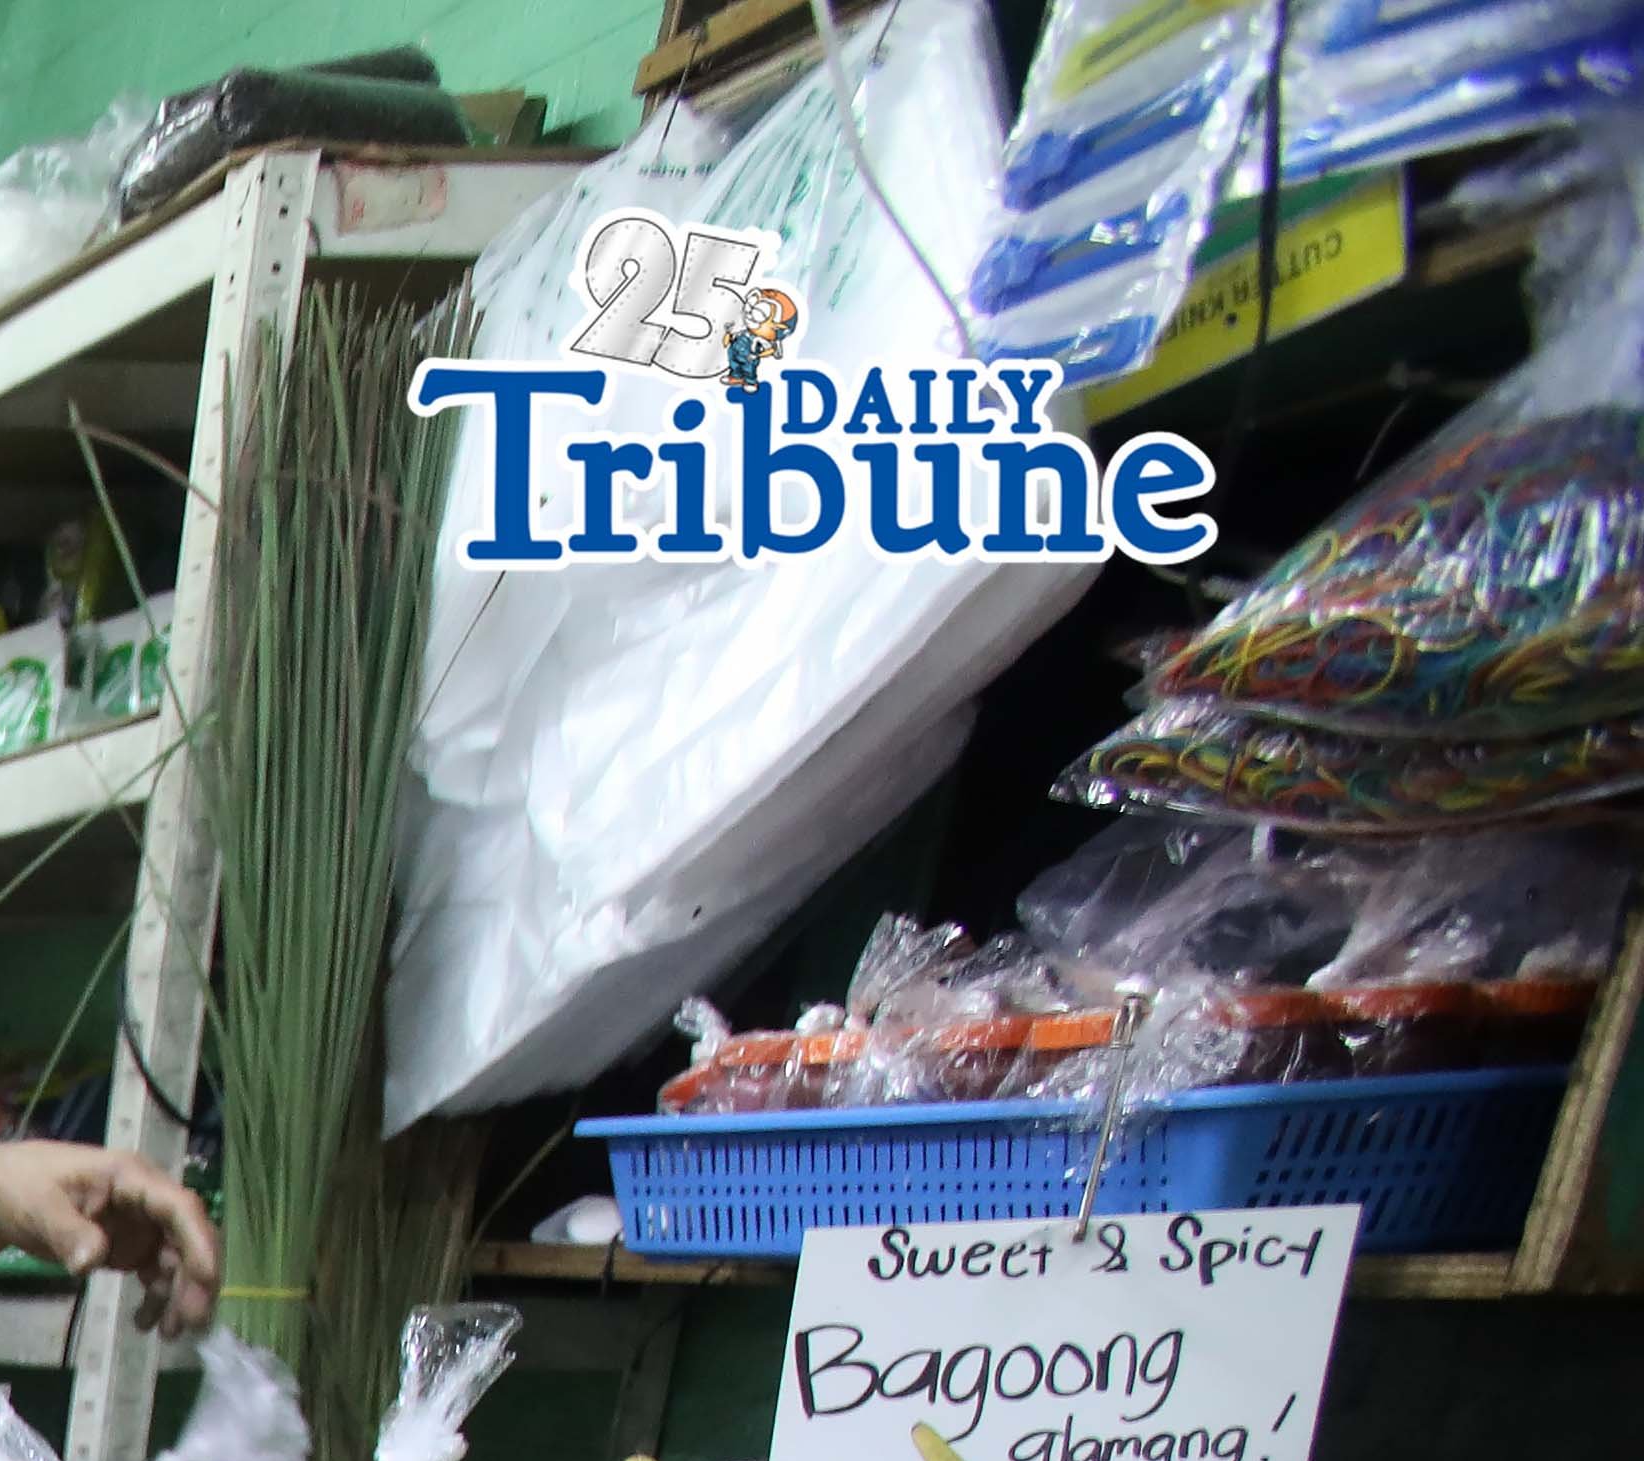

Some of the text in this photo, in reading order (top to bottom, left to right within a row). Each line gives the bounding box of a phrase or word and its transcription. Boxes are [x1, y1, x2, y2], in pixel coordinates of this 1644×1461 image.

[868, 1213, 1325, 1286] Sweet & Spicy
[795, 1322, 1186, 1444] Bagoong
